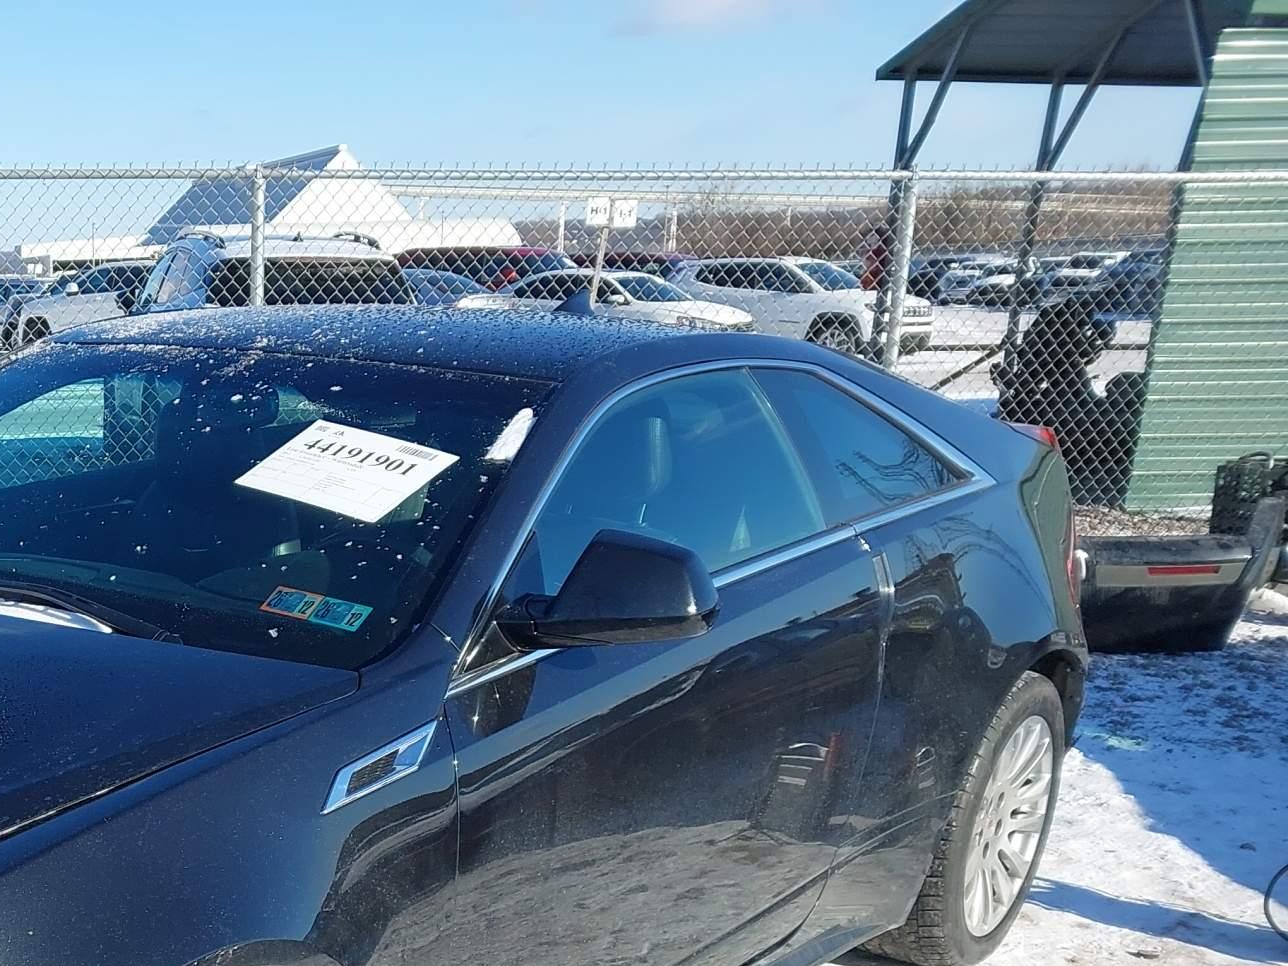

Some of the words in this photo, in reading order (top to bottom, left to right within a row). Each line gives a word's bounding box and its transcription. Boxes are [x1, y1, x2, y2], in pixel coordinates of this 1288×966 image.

[303, 437, 420, 477] 44191901
[297, 599, 316, 615] 12
[344, 612, 363, 627] 12
